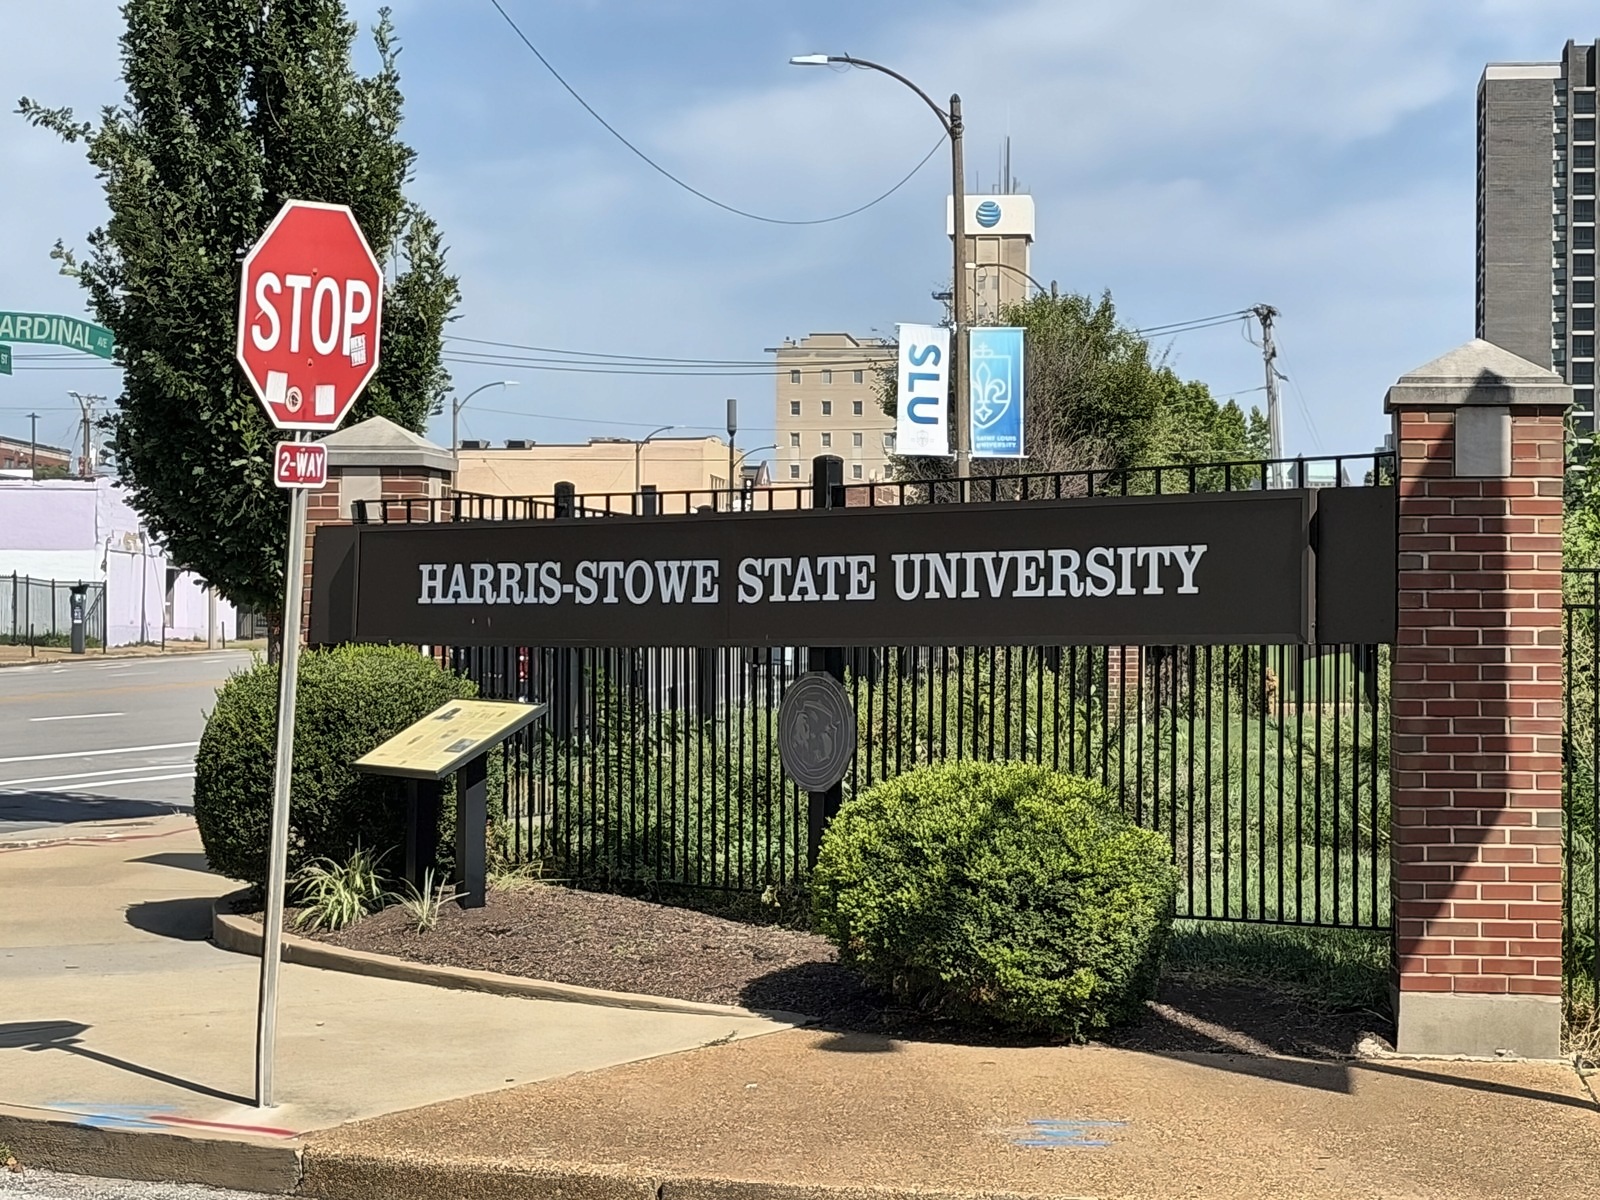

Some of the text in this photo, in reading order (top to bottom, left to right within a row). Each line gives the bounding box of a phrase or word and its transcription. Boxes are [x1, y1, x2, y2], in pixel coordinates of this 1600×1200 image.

[252, 272, 372, 357] STOP
[907, 343, 941, 425] SLU
[280, 453, 324, 478] 2-WAY
[417, 544, 1208, 605] HARRIS-STOWE STATE UNIVERSITY
